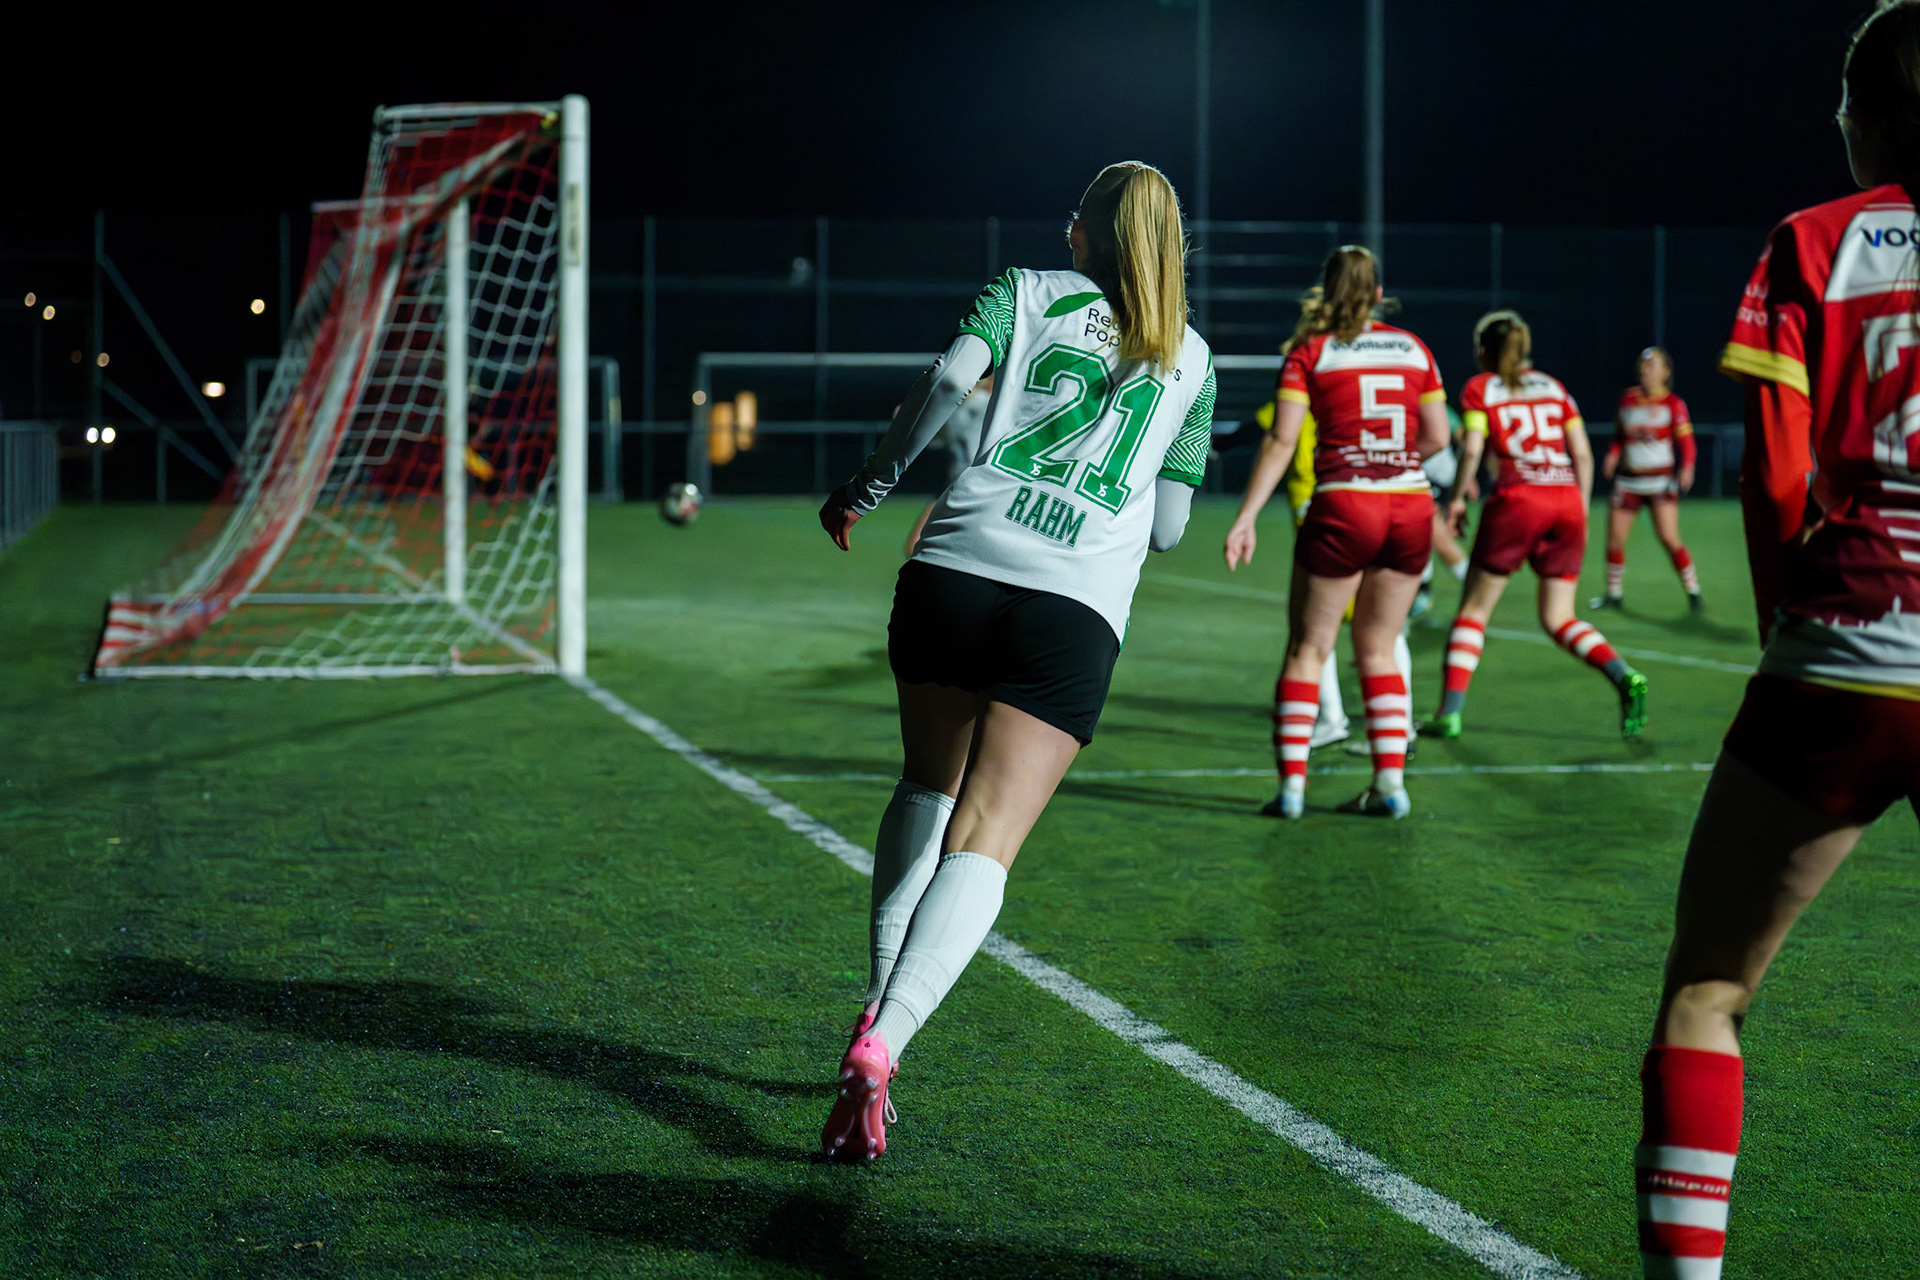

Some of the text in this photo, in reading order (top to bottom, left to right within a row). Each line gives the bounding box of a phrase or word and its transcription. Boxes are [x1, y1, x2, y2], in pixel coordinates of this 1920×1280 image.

[990, 342, 1165, 516] 21
[1359, 374, 1406, 451] 5
[1497, 403, 1573, 466] 25
[1004, 485, 1088, 548] RAHM
